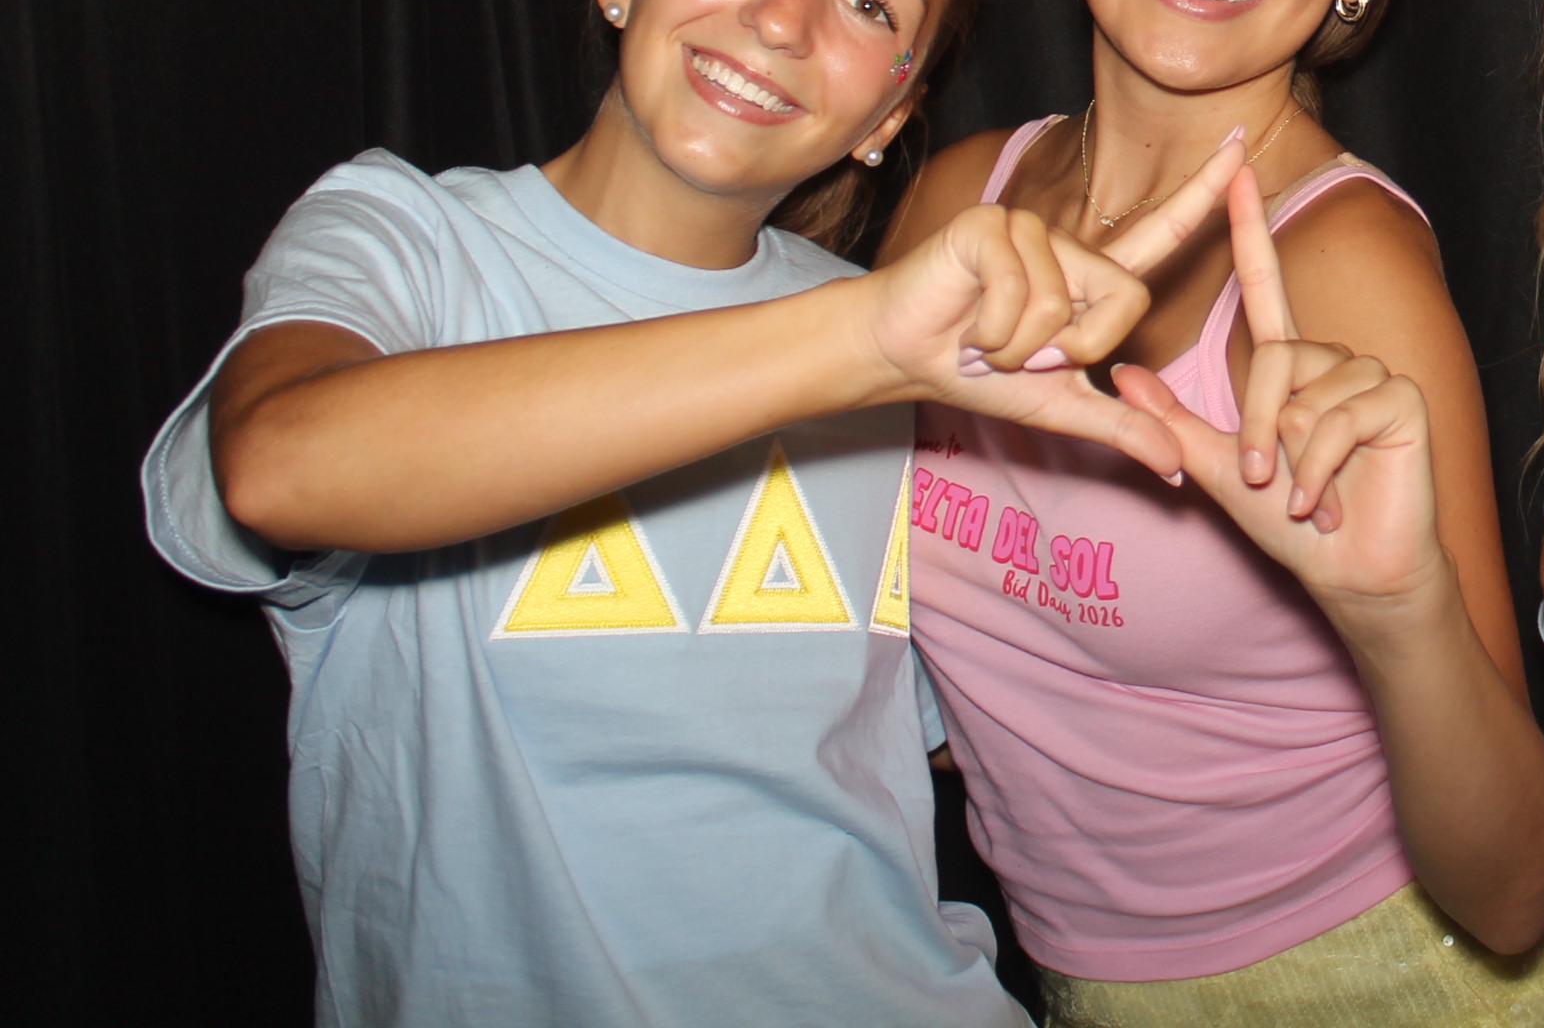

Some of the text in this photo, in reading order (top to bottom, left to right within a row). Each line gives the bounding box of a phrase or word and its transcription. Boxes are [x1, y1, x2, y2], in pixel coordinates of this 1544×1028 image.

[911, 467, 1119, 600] ELTA DEL SOL
[1002, 569, 1124, 627] Bid Day 2026
